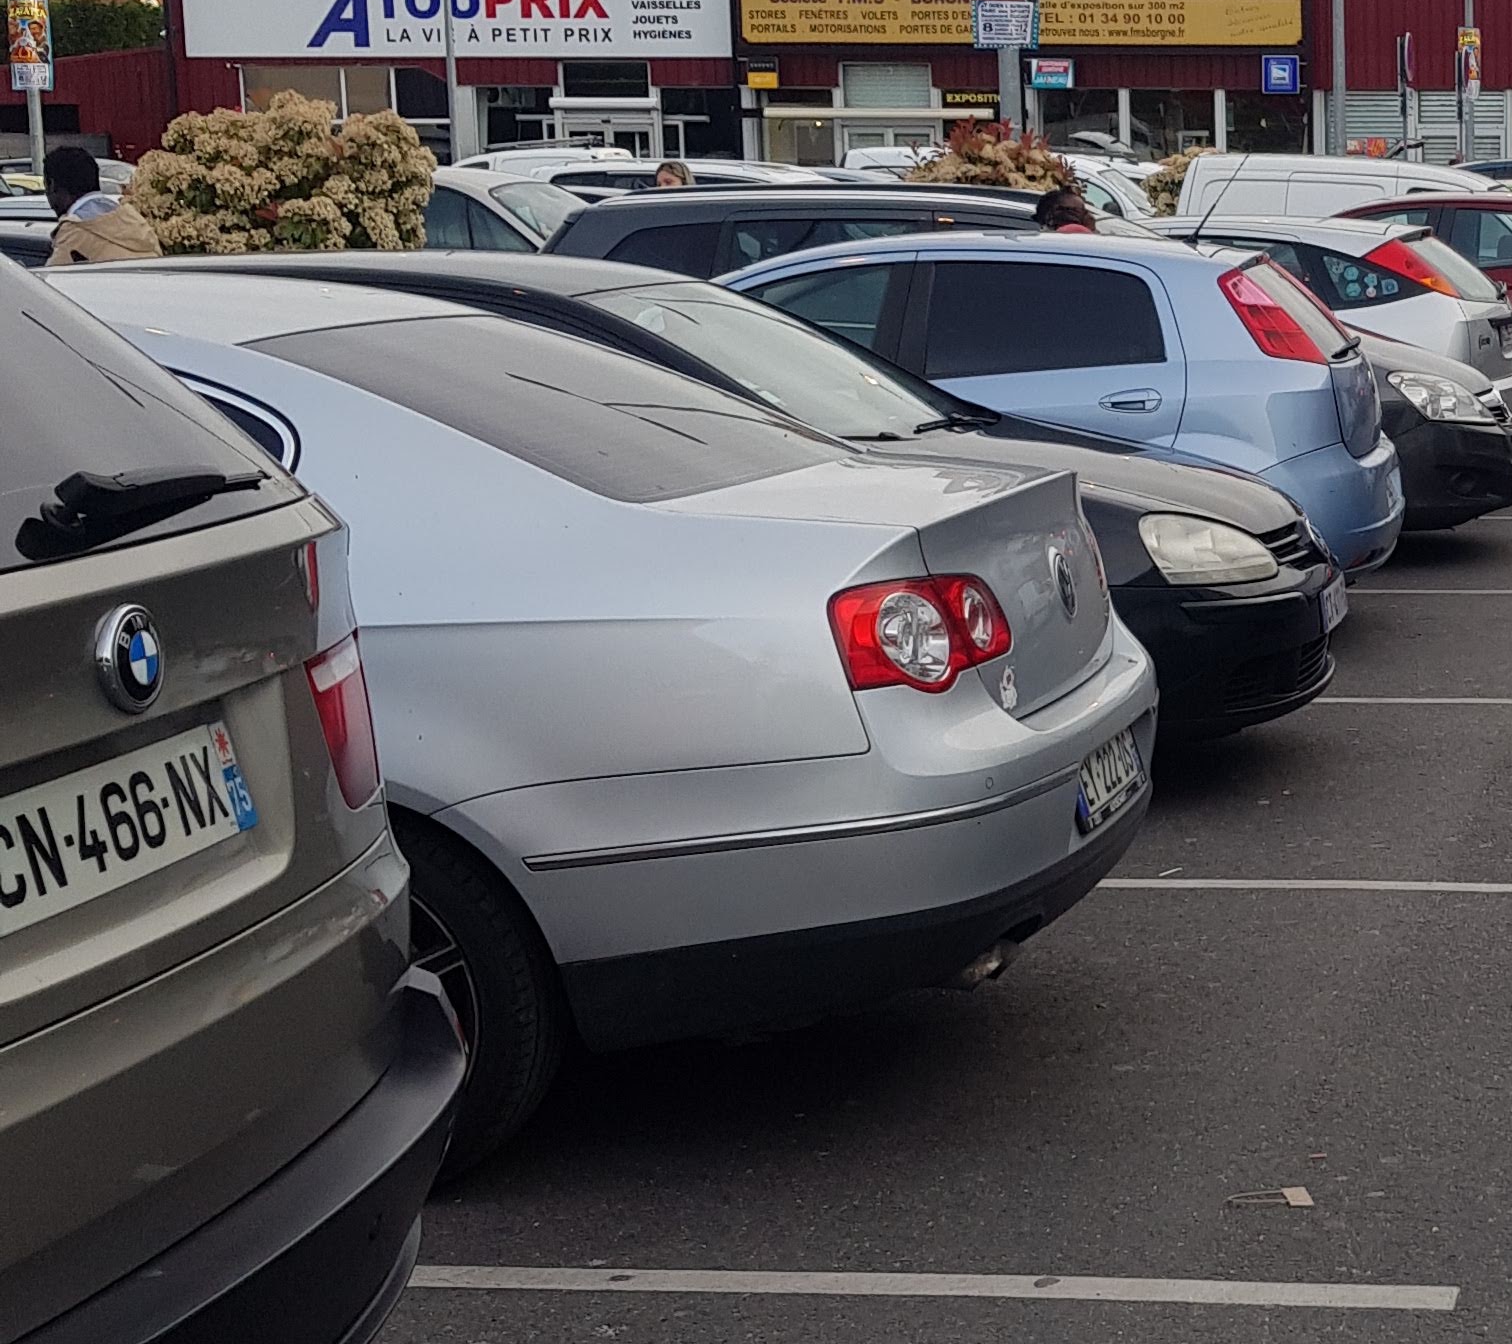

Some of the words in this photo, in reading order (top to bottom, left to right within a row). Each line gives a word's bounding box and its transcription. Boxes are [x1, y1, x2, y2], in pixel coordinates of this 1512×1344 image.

[631, 0, 702, 10] VAISSELLES
[1039, 0, 1058, 10] alle
[1148, 1, 1166, 10] 300
[631, 15, 679, 25] JOUETS
[748, 10, 787, 20] STORES
[861, 10, 899, 21] VOLETS
[911, 10, 949, 21] PORTES
[1078, 12, 1095, 24] 01
[1100, 12, 1118, 24] 34
[1123, 12, 1141, 25] 90
[1146, 13, 1163, 25] 10
[1167, 13, 1186, 25] 00
[386, 27, 412, 43] LA
[421, 27, 456, 43] VI
[466, 22, 480, 43] À
[491, 27, 551, 43] PETIT
[563, 27, 613, 43] PRIX
[750, 23, 797, 34] PORTAILS
[809, 23, 887, 35] MOTORISATIONS
[899, 24, 938, 35] PORTES
[940, 24, 953, 35] DE
[1039, 26, 1077, 37] etrouvez
[1078, 28, 1100, 37] nous
